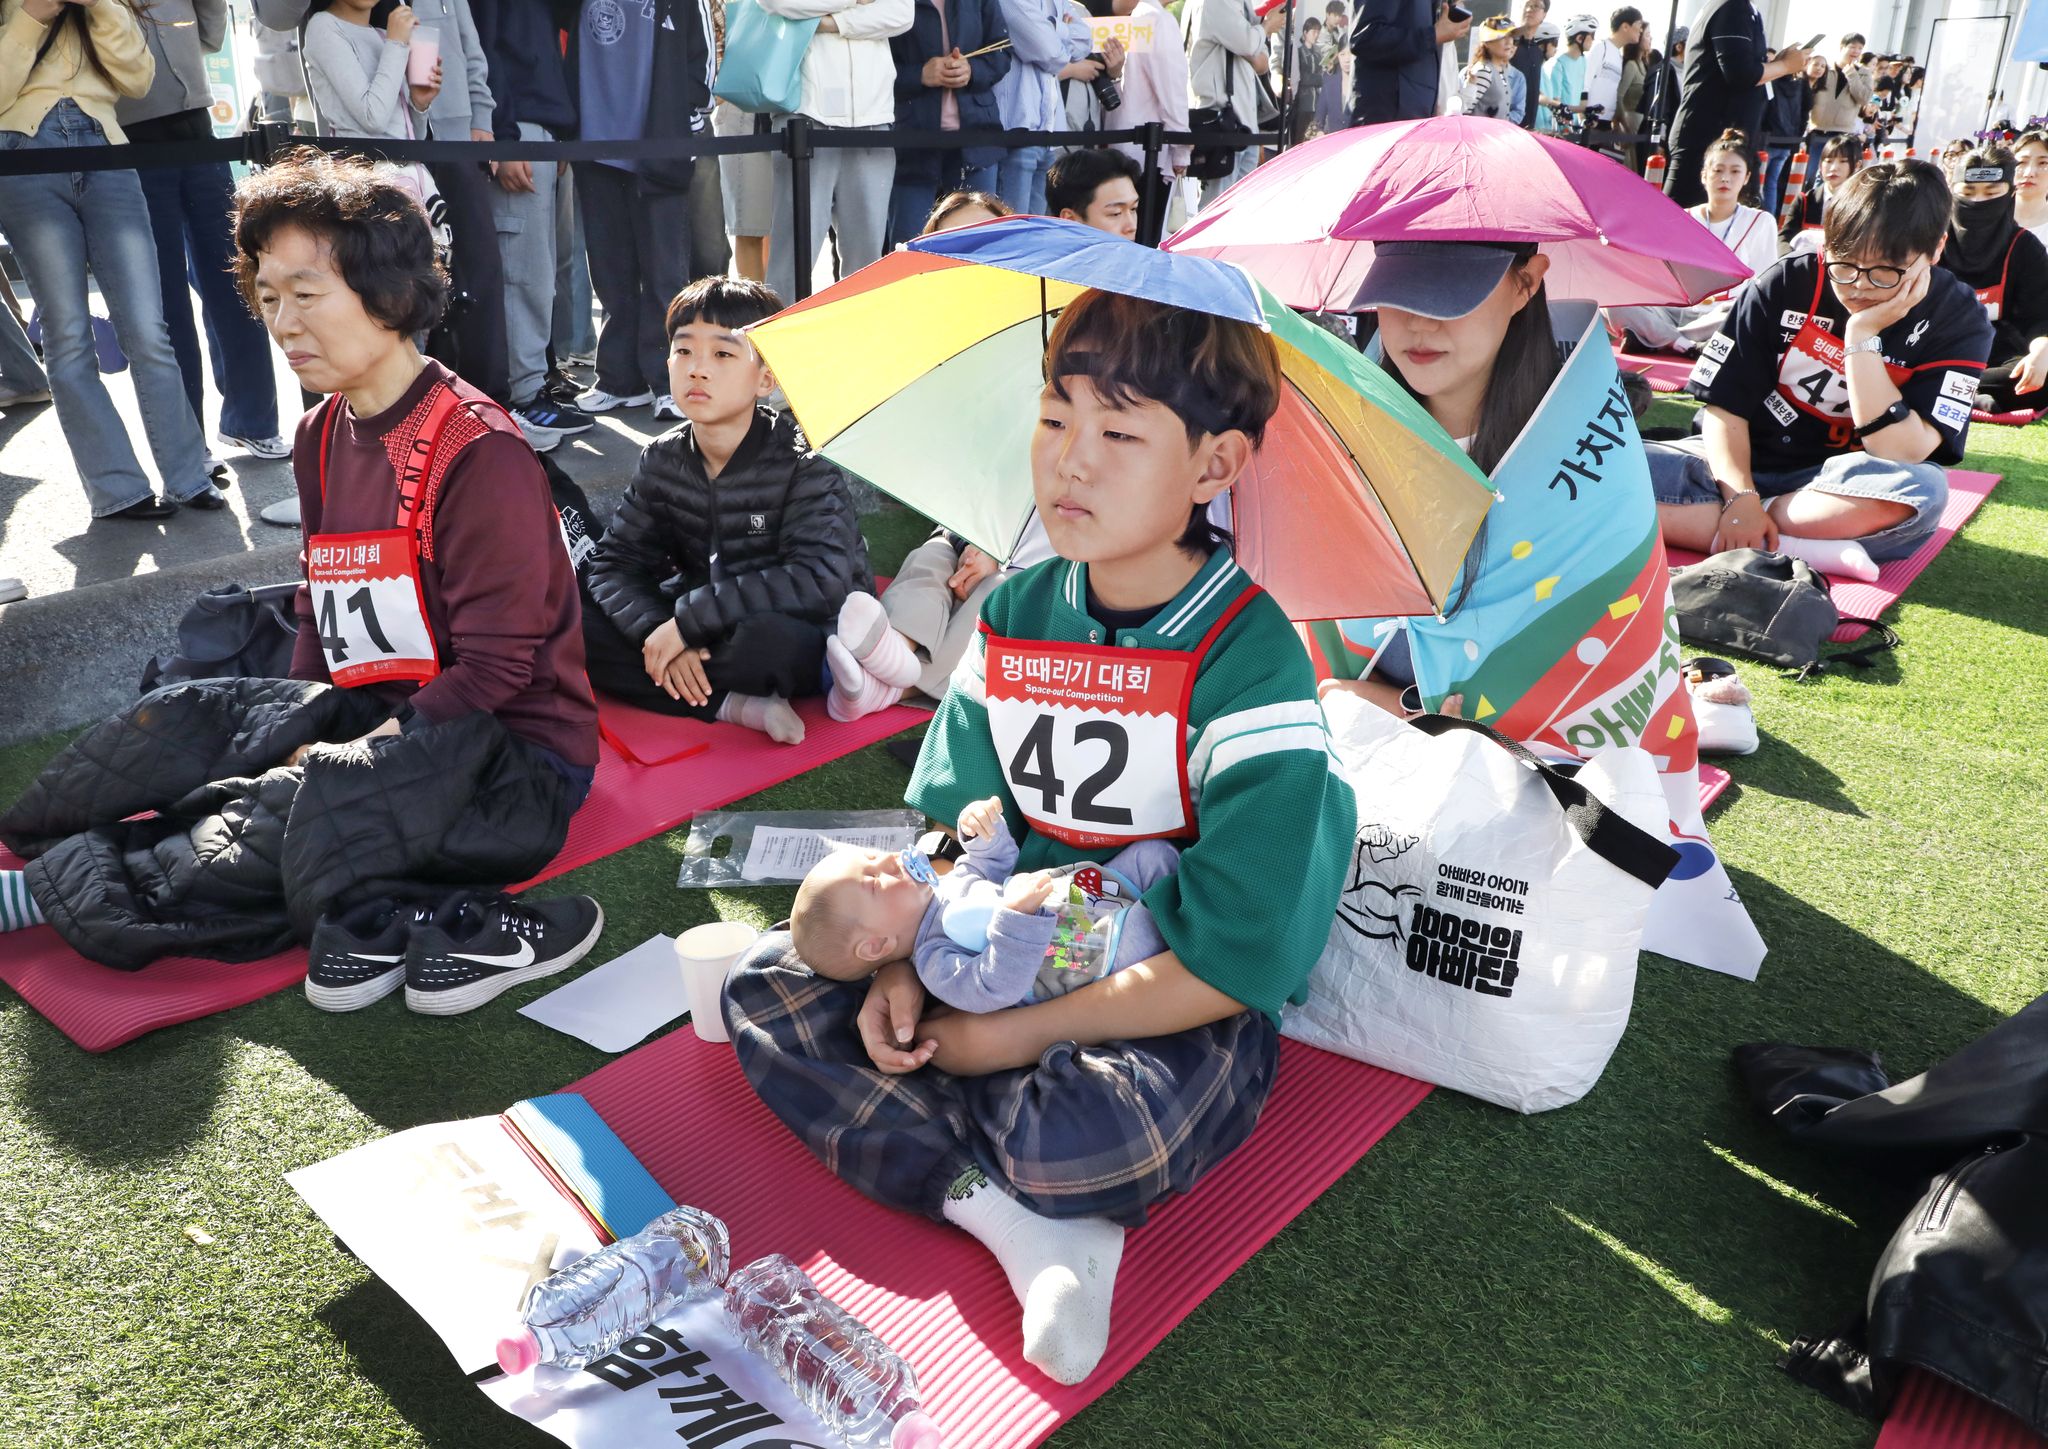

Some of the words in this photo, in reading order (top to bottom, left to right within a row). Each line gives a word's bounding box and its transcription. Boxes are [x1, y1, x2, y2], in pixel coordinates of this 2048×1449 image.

[1091, 23, 1154, 52] 우왕자
[1708, 339, 1730, 357] 오션
[1813, 337, 1846, 365] 멍때리
[1767, 394, 1795, 423] 손해보험
[353, 543, 381, 566] 대회
[333, 566, 367, 577] Competition
[319, 586, 397, 664] 41
[1001, 655, 1092, 688] 멍때리기
[1098, 663, 1151, 694] 대회
[1025, 684, 1064, 697] Space-out
[1065, 688, 1124, 704] Competition
[1009, 713, 1134, 826] 42
[1438, 863, 1486, 887] 아빠와
[1487, 874, 1529, 896] 아이가
[1436, 880, 1466, 901] 함께
[1465, 888, 1525, 915] 만들어가는
[1410, 903, 1523, 960] 100인의
[1406, 933, 1520, 998] 아빠단
